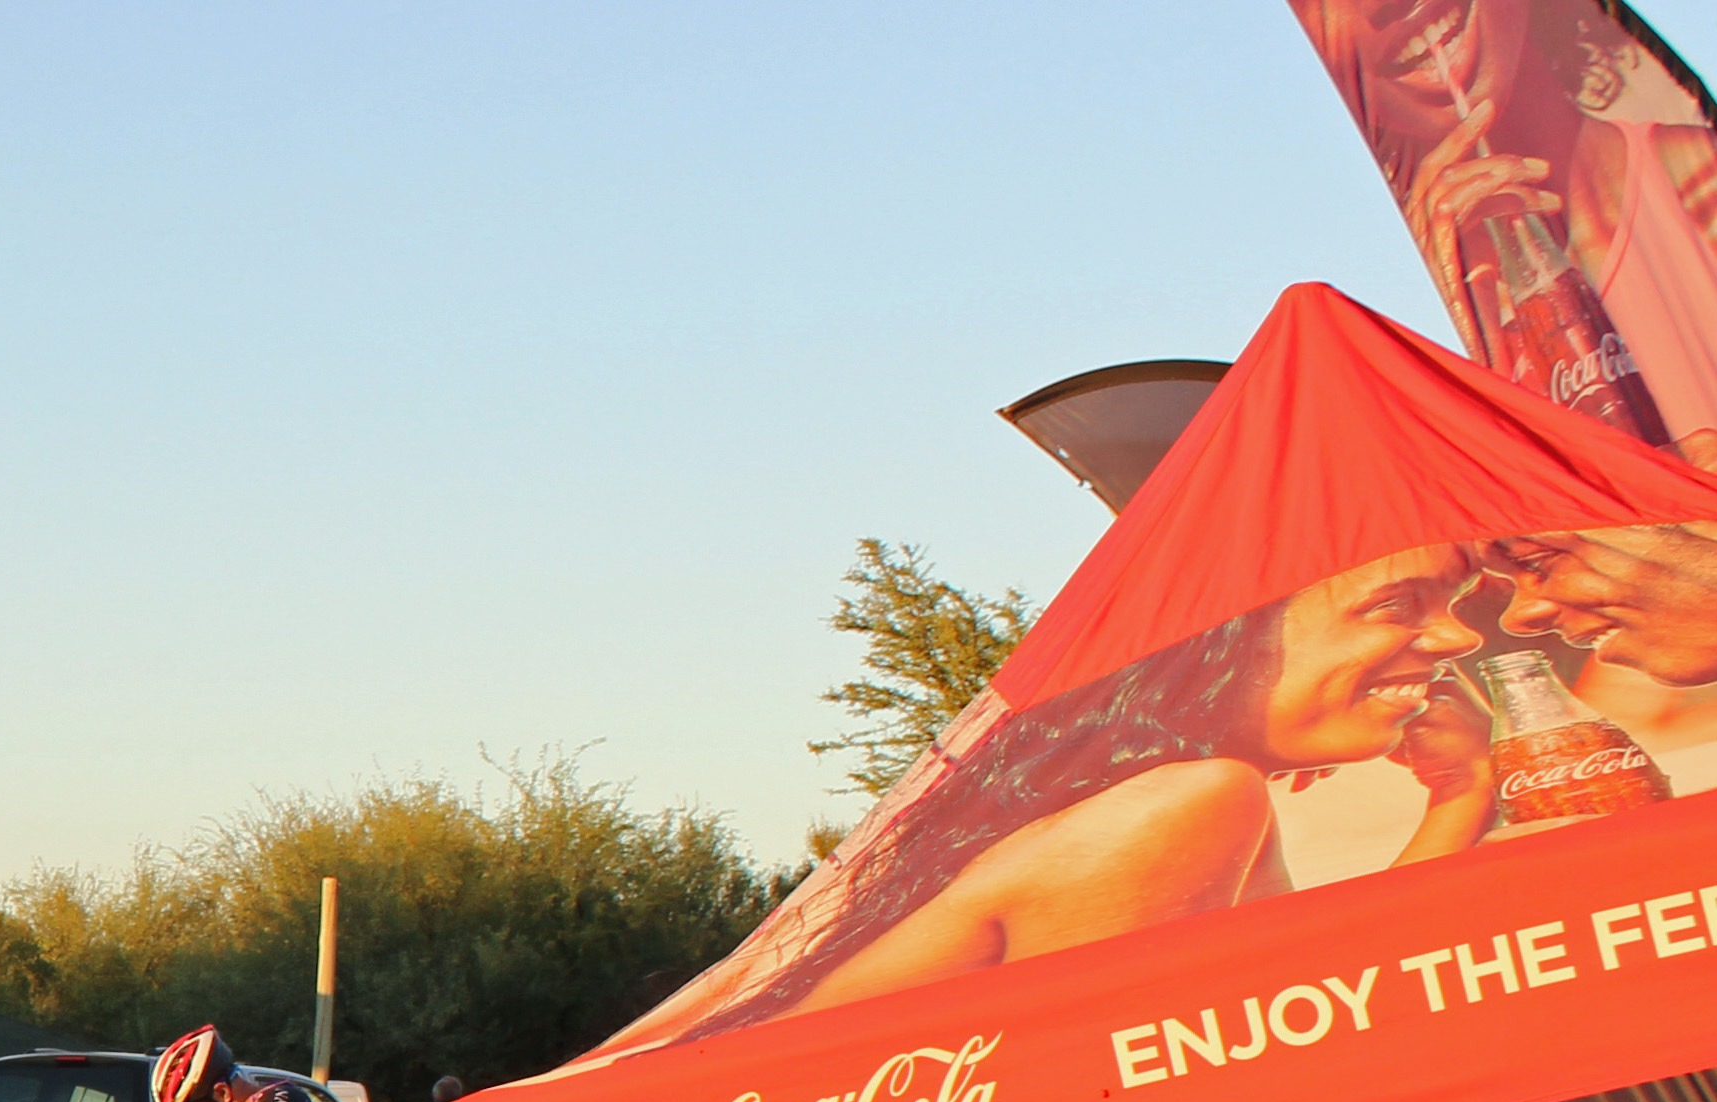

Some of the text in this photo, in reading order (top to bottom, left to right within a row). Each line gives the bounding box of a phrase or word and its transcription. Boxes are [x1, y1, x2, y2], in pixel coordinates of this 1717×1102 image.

[1500, 746, 1649, 800] Coca-Cola
[1110, 966, 1380, 1090] ENJOY
[1400, 920, 1576, 1013] THE
